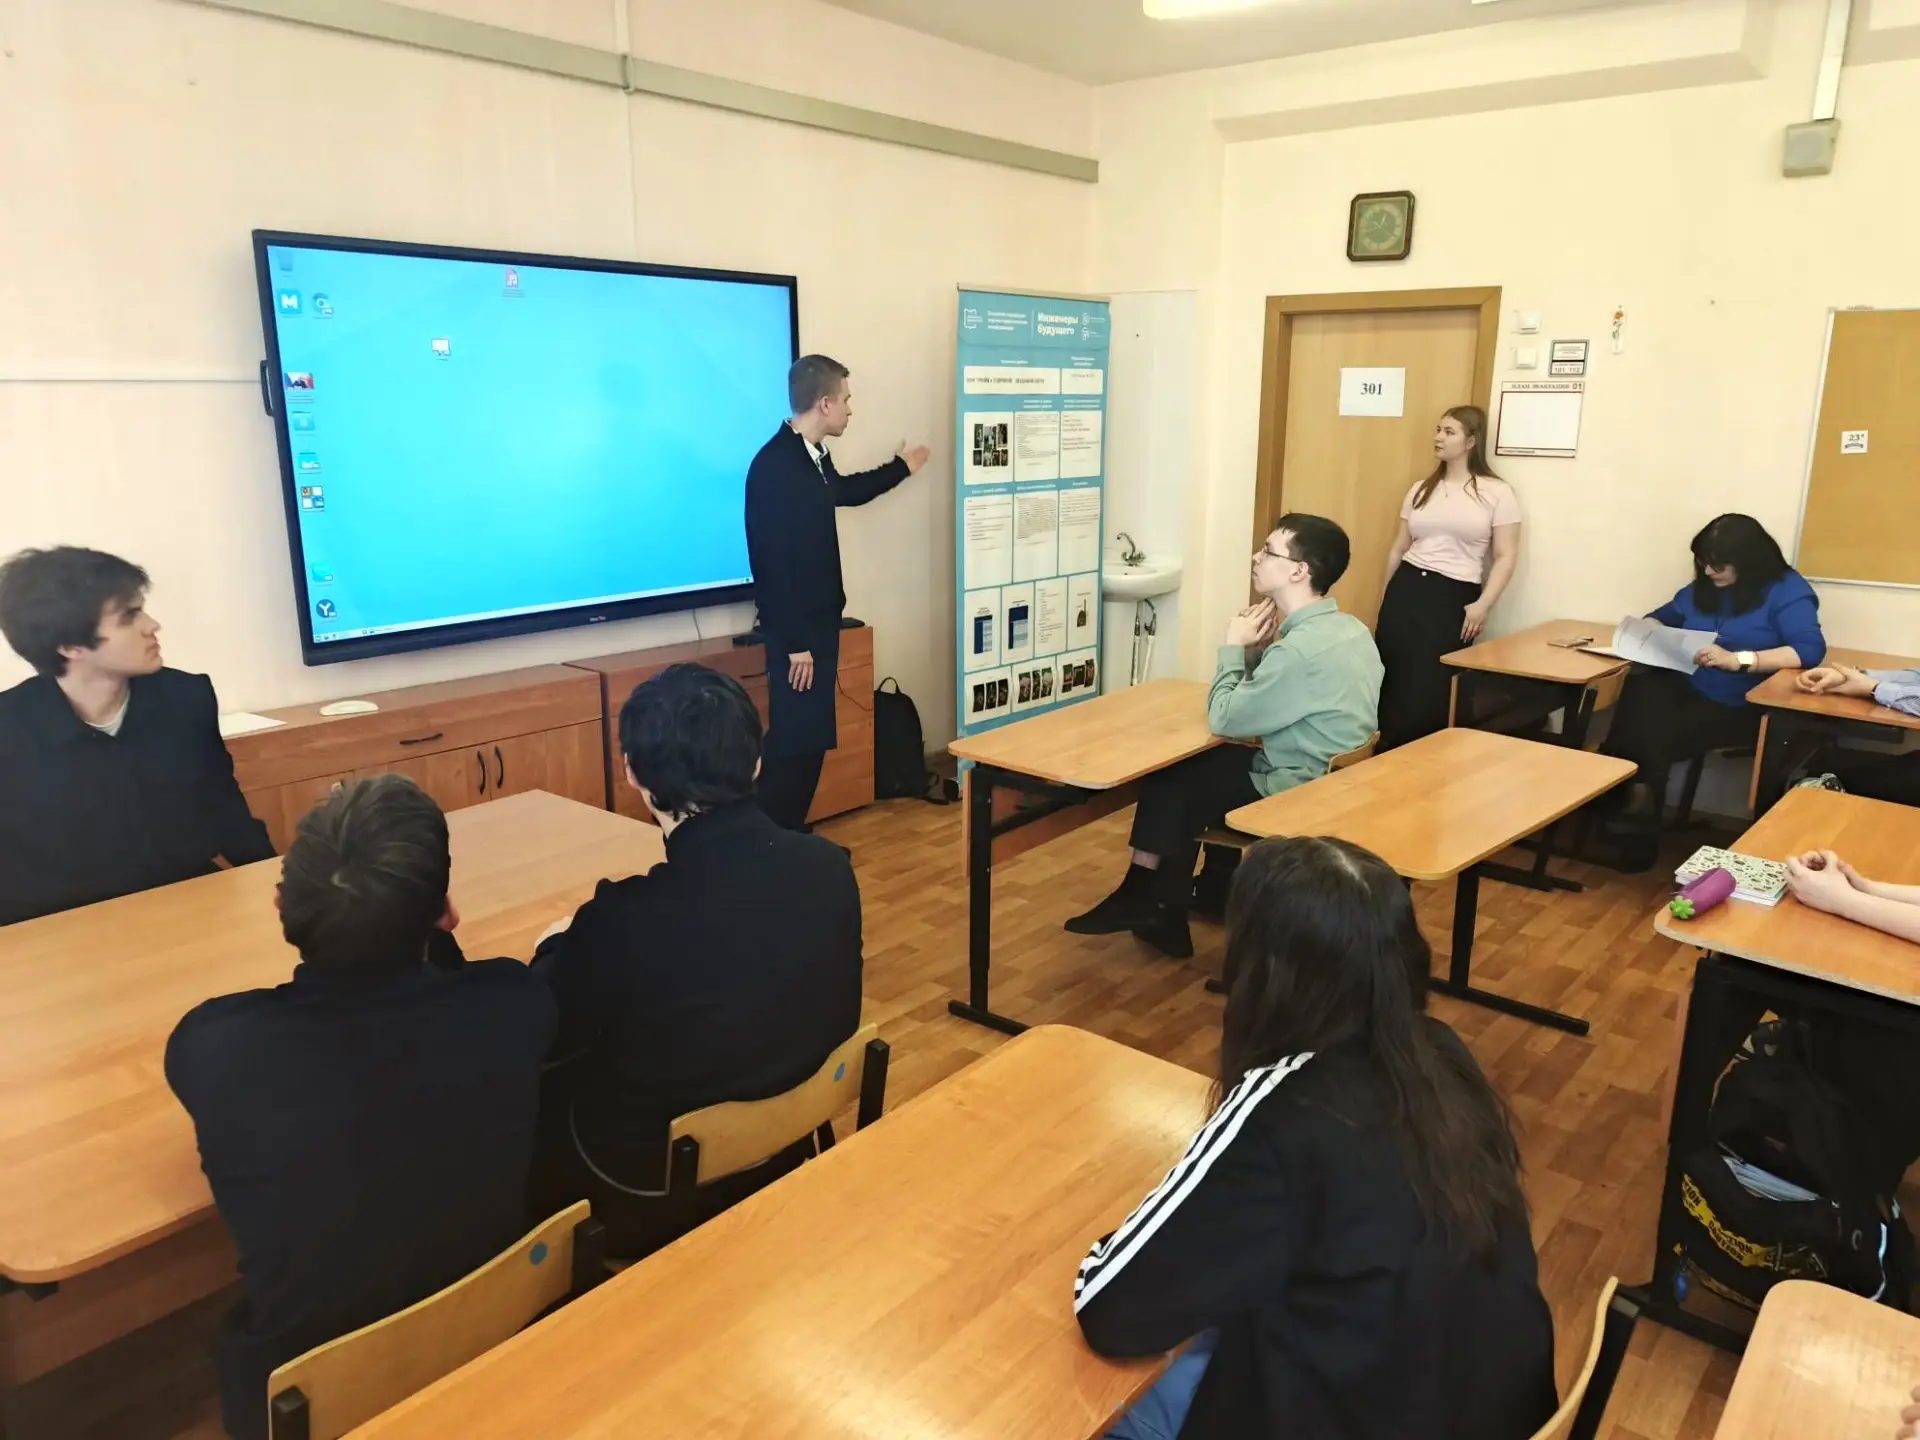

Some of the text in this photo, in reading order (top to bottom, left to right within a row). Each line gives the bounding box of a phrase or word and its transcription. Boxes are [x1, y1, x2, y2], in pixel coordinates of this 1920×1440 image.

[1037, 312, 1079, 325] Инженеры
[1037, 323, 1075, 336] будущего
[1360, 382, 1382, 395] 301
